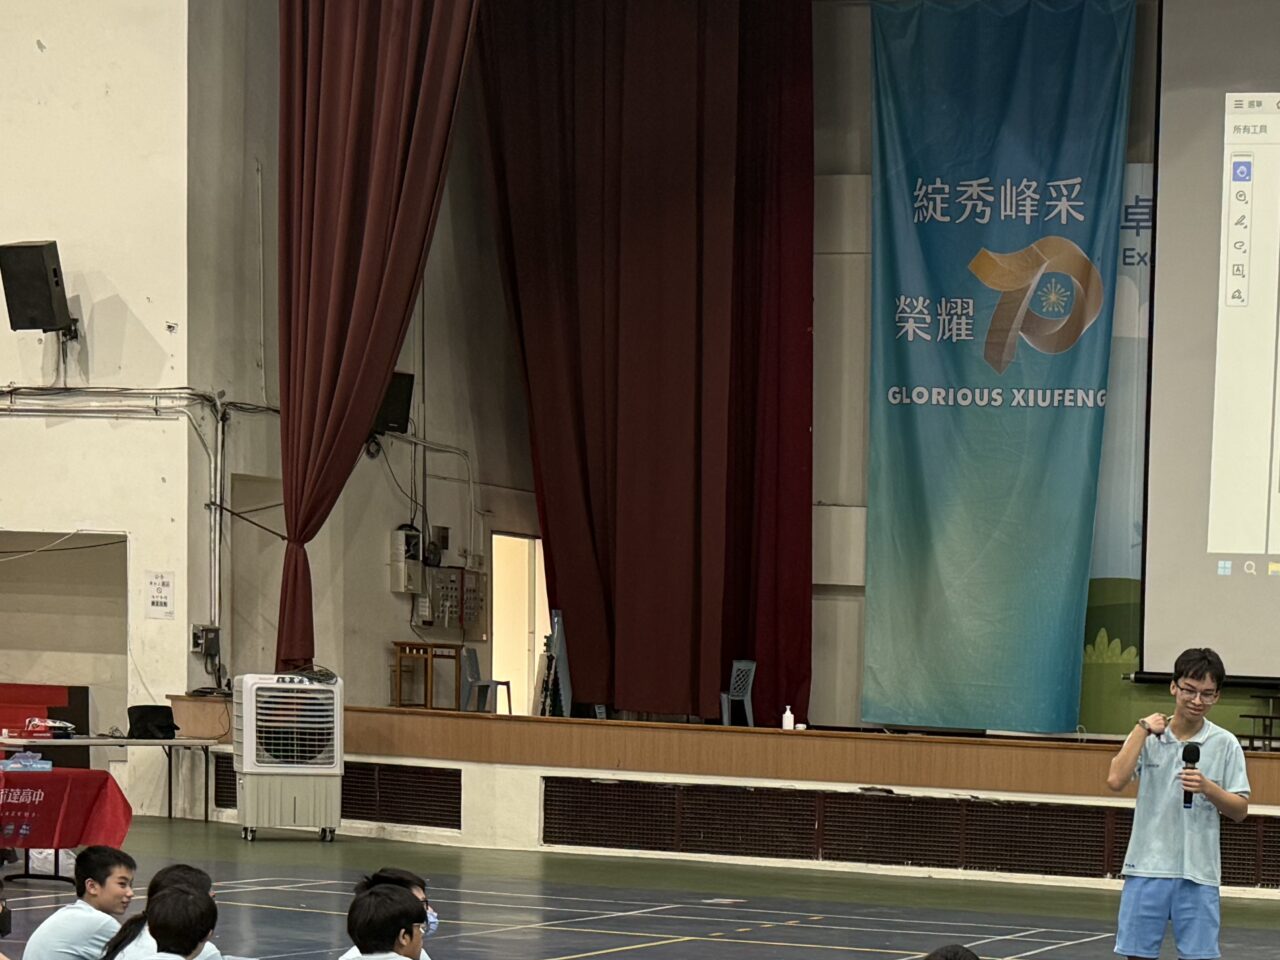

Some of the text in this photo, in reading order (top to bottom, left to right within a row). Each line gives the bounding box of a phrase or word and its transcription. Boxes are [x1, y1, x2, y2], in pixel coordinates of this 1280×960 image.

[913, 176, 1086, 225] 綻秀峰采
[894, 294, 976, 343] 榮耀
[887, 386, 1107, 408] GLORIOUS XIUFENG
